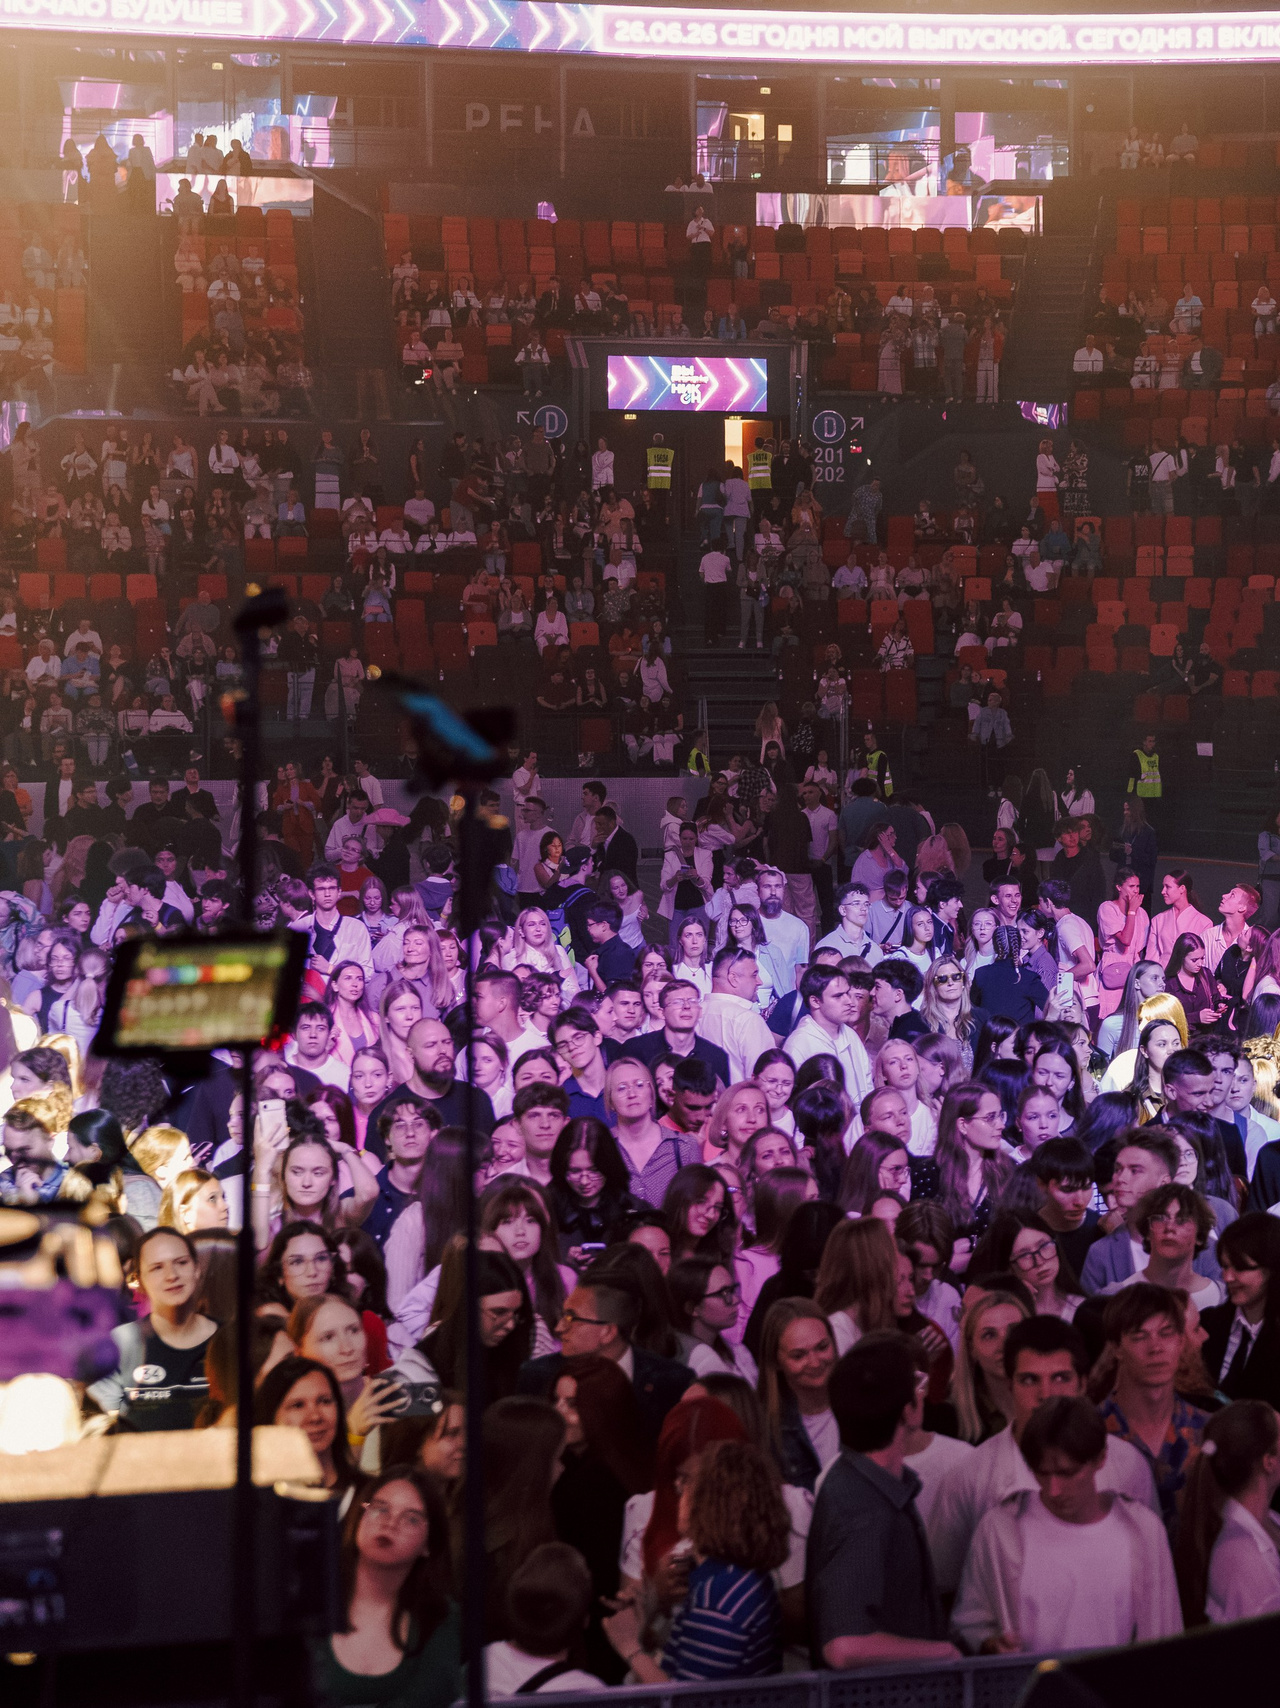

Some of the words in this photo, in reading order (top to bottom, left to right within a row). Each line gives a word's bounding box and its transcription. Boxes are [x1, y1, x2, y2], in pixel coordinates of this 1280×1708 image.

[614, 19, 717, 45] 26.06.26
[721, 23, 839, 51] СЕГОДНЯ
[844, 23, 902, 50] МОЙ
[1076, 26, 1191, 52] СЕГОДНЯ
[1196, 25, 1213, 48] Я
[545, 411, 559, 433] D
[823, 416, 837, 438] D
[814, 447, 843, 463] 201
[814, 466, 845, 482] 202
